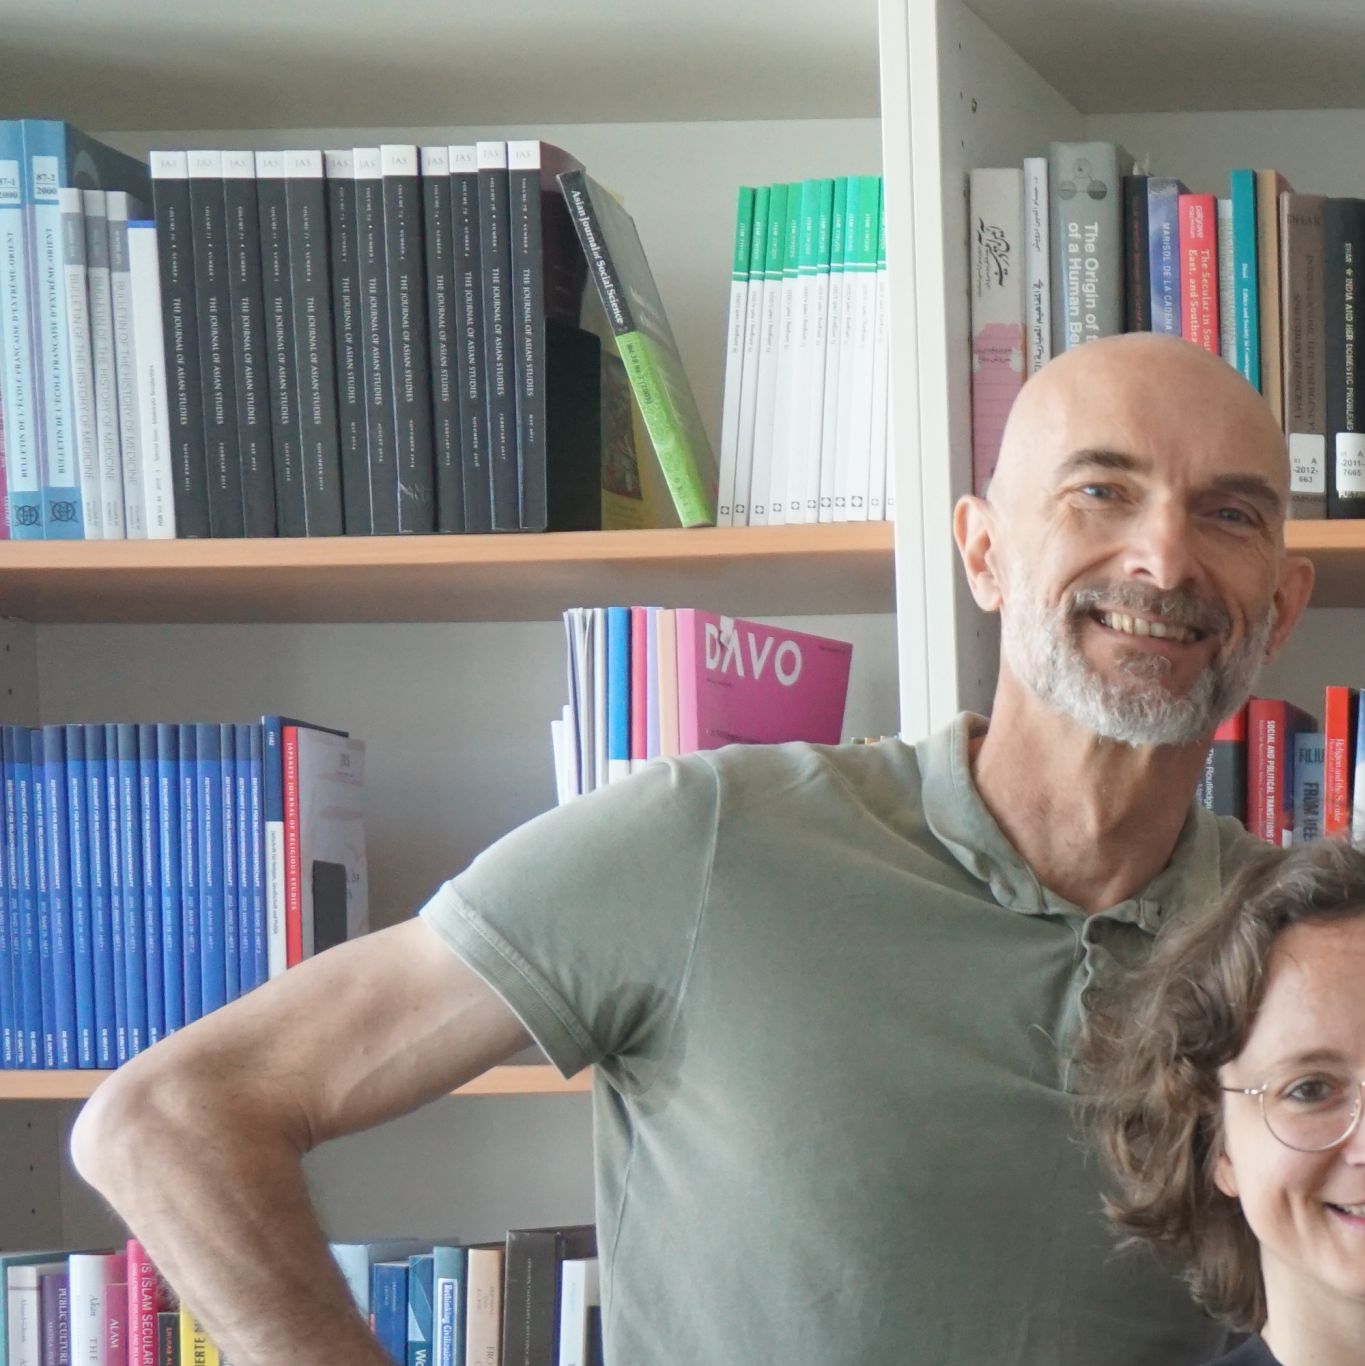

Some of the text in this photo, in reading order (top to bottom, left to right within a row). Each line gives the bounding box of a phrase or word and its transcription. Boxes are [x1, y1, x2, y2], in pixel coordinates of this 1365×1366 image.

[570, 188, 626, 325] Asian Journal of Social Science
[399, 274, 413, 403] THE JOURNAL OF ASIAN STUDIES
[521, 268, 535, 396] THE JOURNAL OF ASIAN STUDIES
[705, 622, 802, 687] DAVO
[140, 1262, 151, 1273] IS
[140, 1276, 151, 1311] ISLAM
[109, 1318, 119, 1348] ALAM
